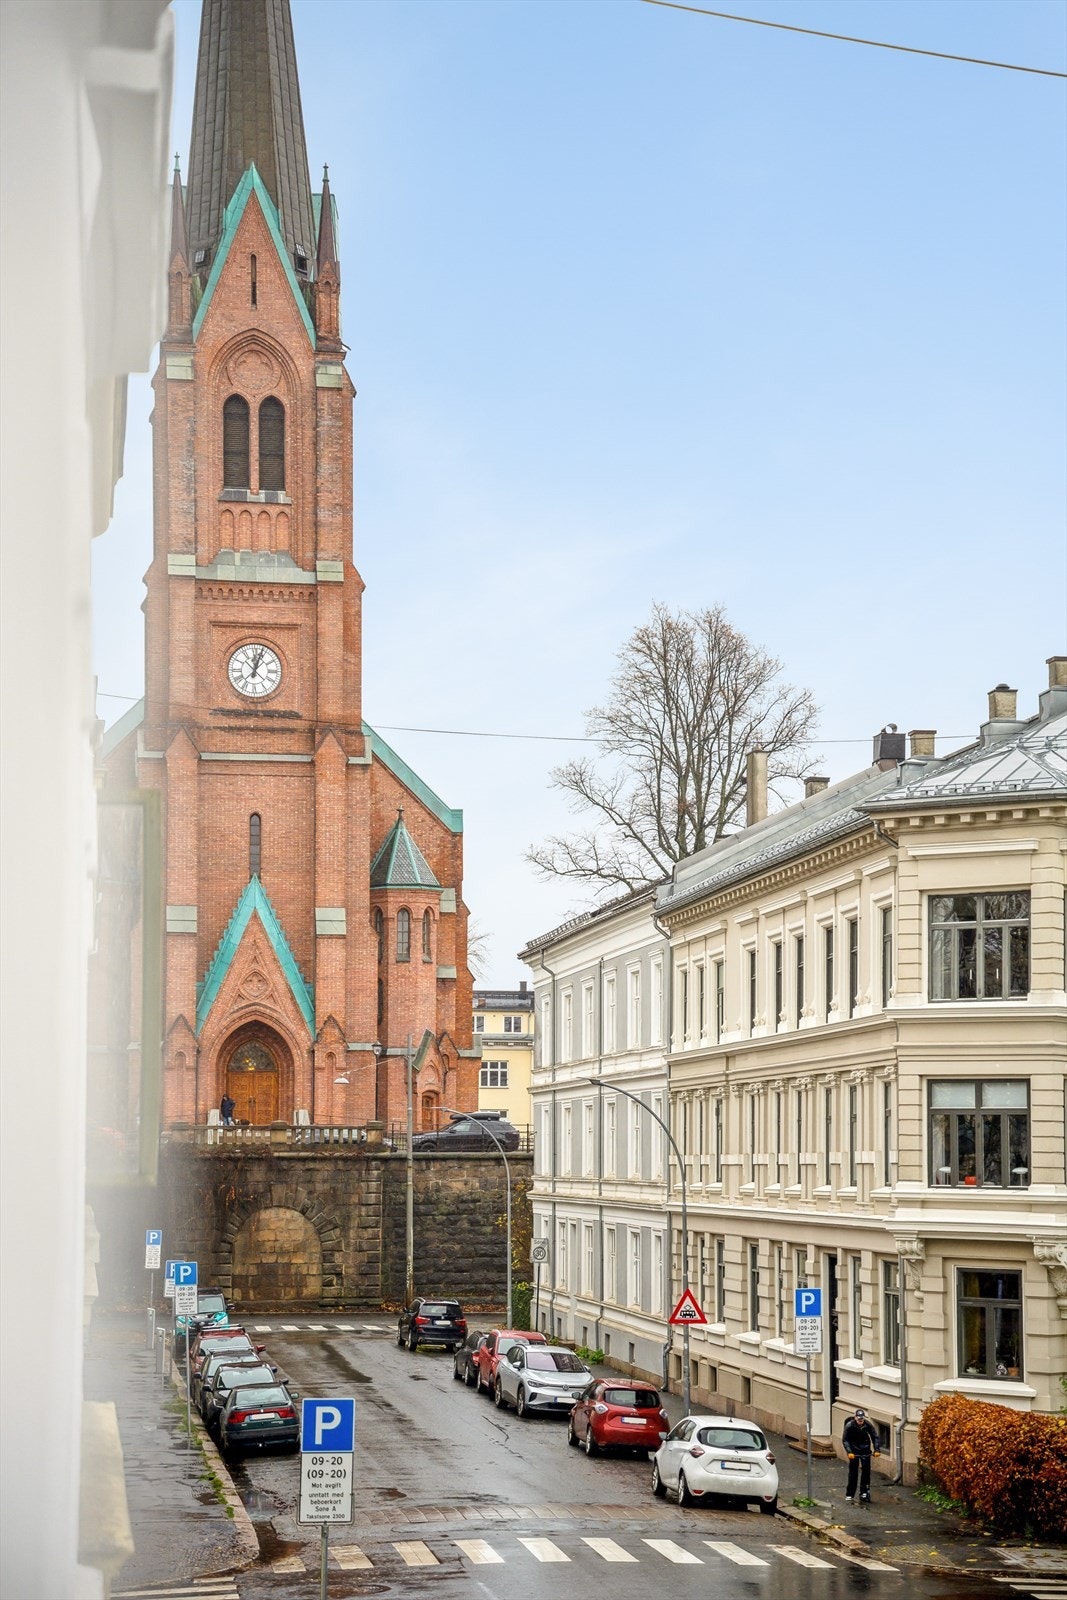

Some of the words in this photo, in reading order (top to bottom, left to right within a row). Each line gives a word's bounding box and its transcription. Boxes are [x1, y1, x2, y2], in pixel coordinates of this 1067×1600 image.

[150, 1232, 158, 1243] P
[180, 1266, 191, 1282] P
[802, 1292, 815, 1313] P
[315, 1406, 342, 1445] P
[312, 1456, 343, 1465] 09-20
[307, 1469, 347, 1479] (09-20)
